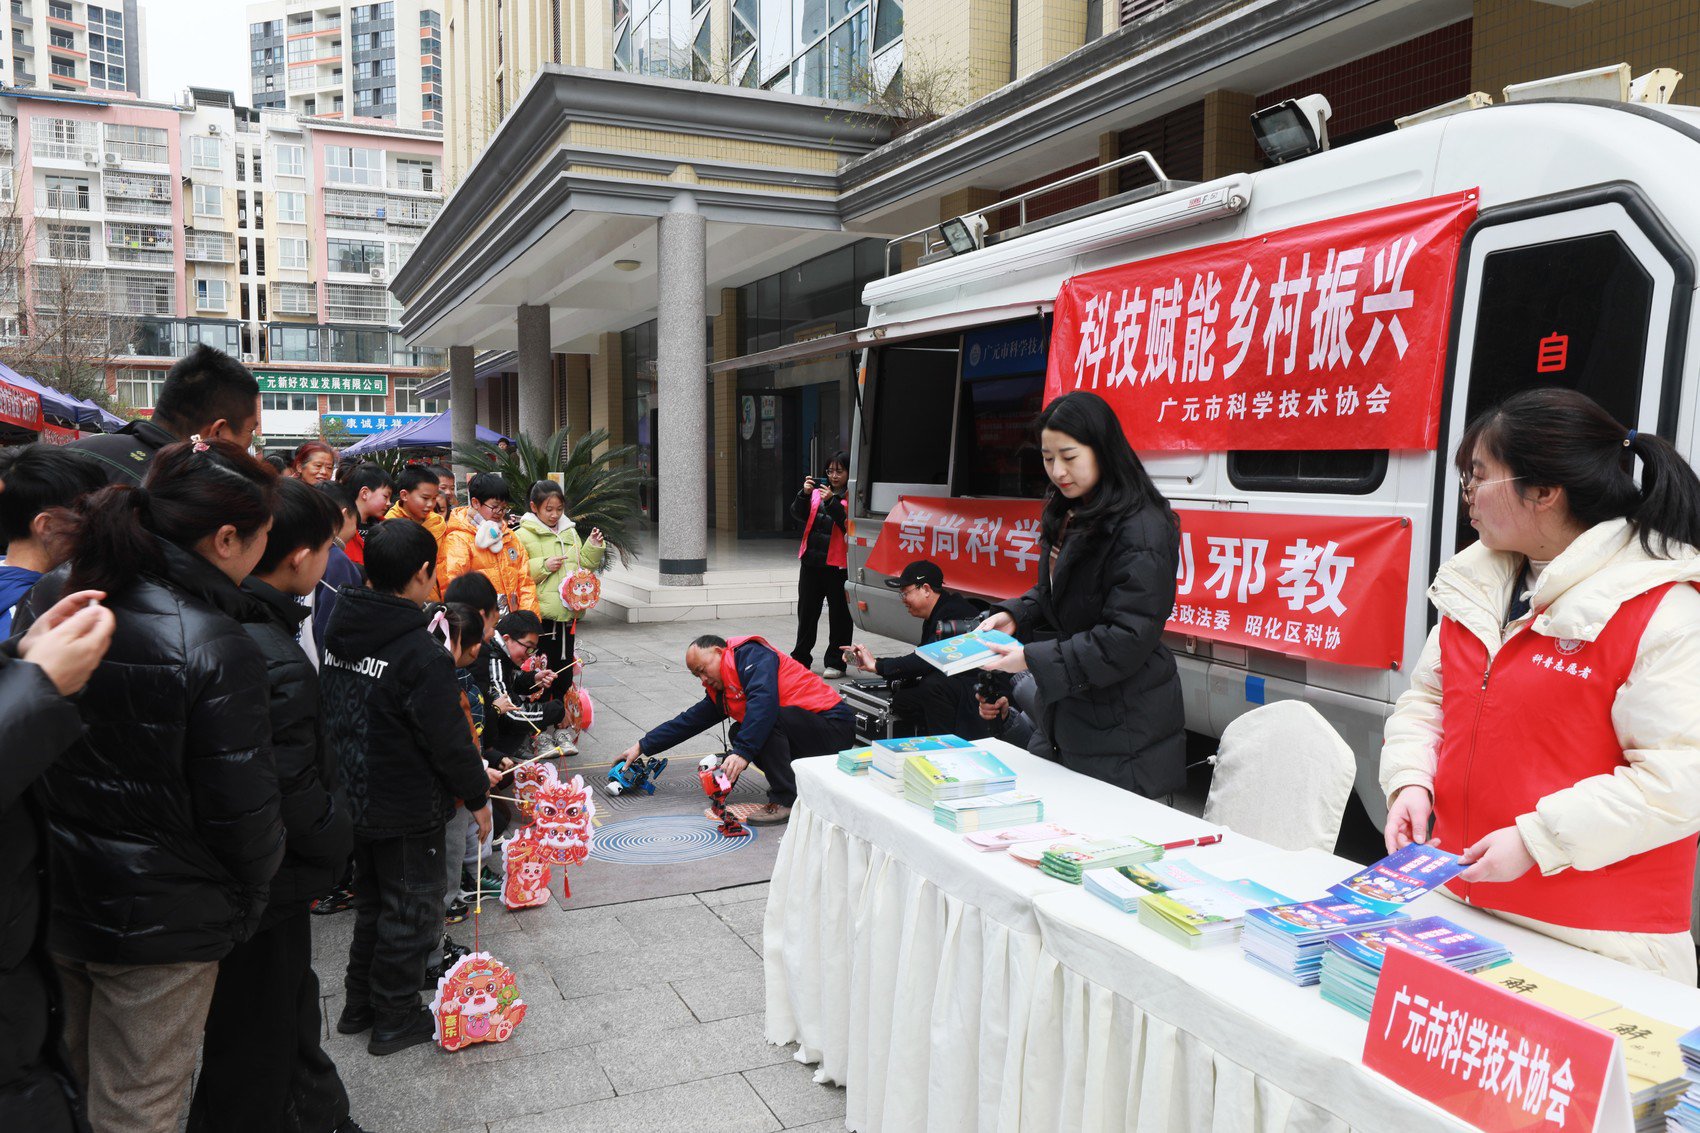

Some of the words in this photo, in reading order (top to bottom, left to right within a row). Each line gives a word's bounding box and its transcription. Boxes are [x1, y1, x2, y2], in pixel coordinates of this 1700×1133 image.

[1074, 236, 1418, 389] 科技赋能乡村振兴
[1537, 331, 1569, 373] 自
[256, 375, 383, 392] 广元新好农业发展有限公司
[1157, 383, 1392, 423] 广元市科学技术协会
[346, 416, 417, 430] 康诚昇祥
[1244, 614, 1342, 650] 昭化区科协
[1531, 653, 1592, 680] 科普志愿者
[1384, 985, 1576, 1128] 广元市科学技术协会
